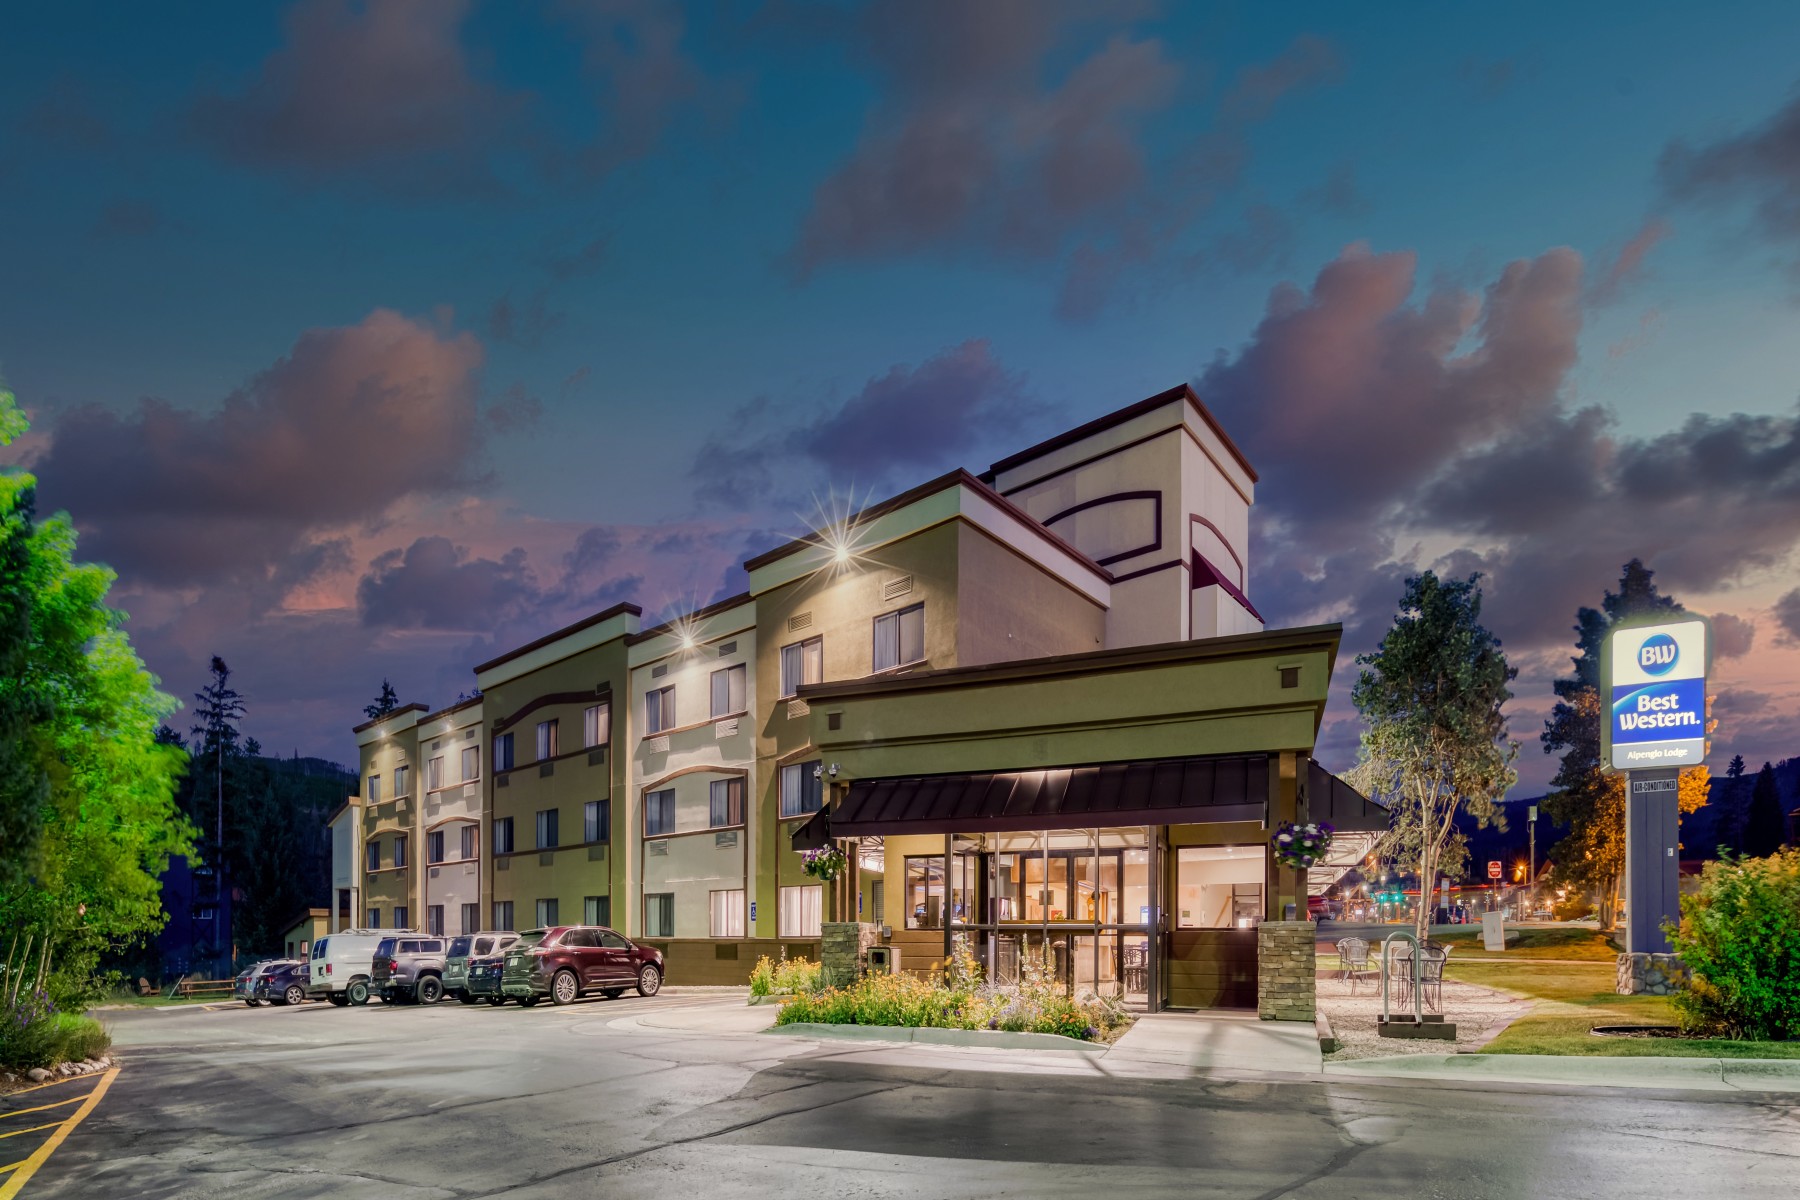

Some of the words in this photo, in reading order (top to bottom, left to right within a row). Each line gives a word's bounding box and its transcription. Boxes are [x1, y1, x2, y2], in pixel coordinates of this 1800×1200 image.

[1641, 644, 1676, 666] BW
[1637, 693, 1679, 712] Best
[1627, 749, 1663, 760] Alpenglo
[1664, 748, 1688, 758] Lodge
[1634, 780, 1676, 792] AIR-CONDITIONED
